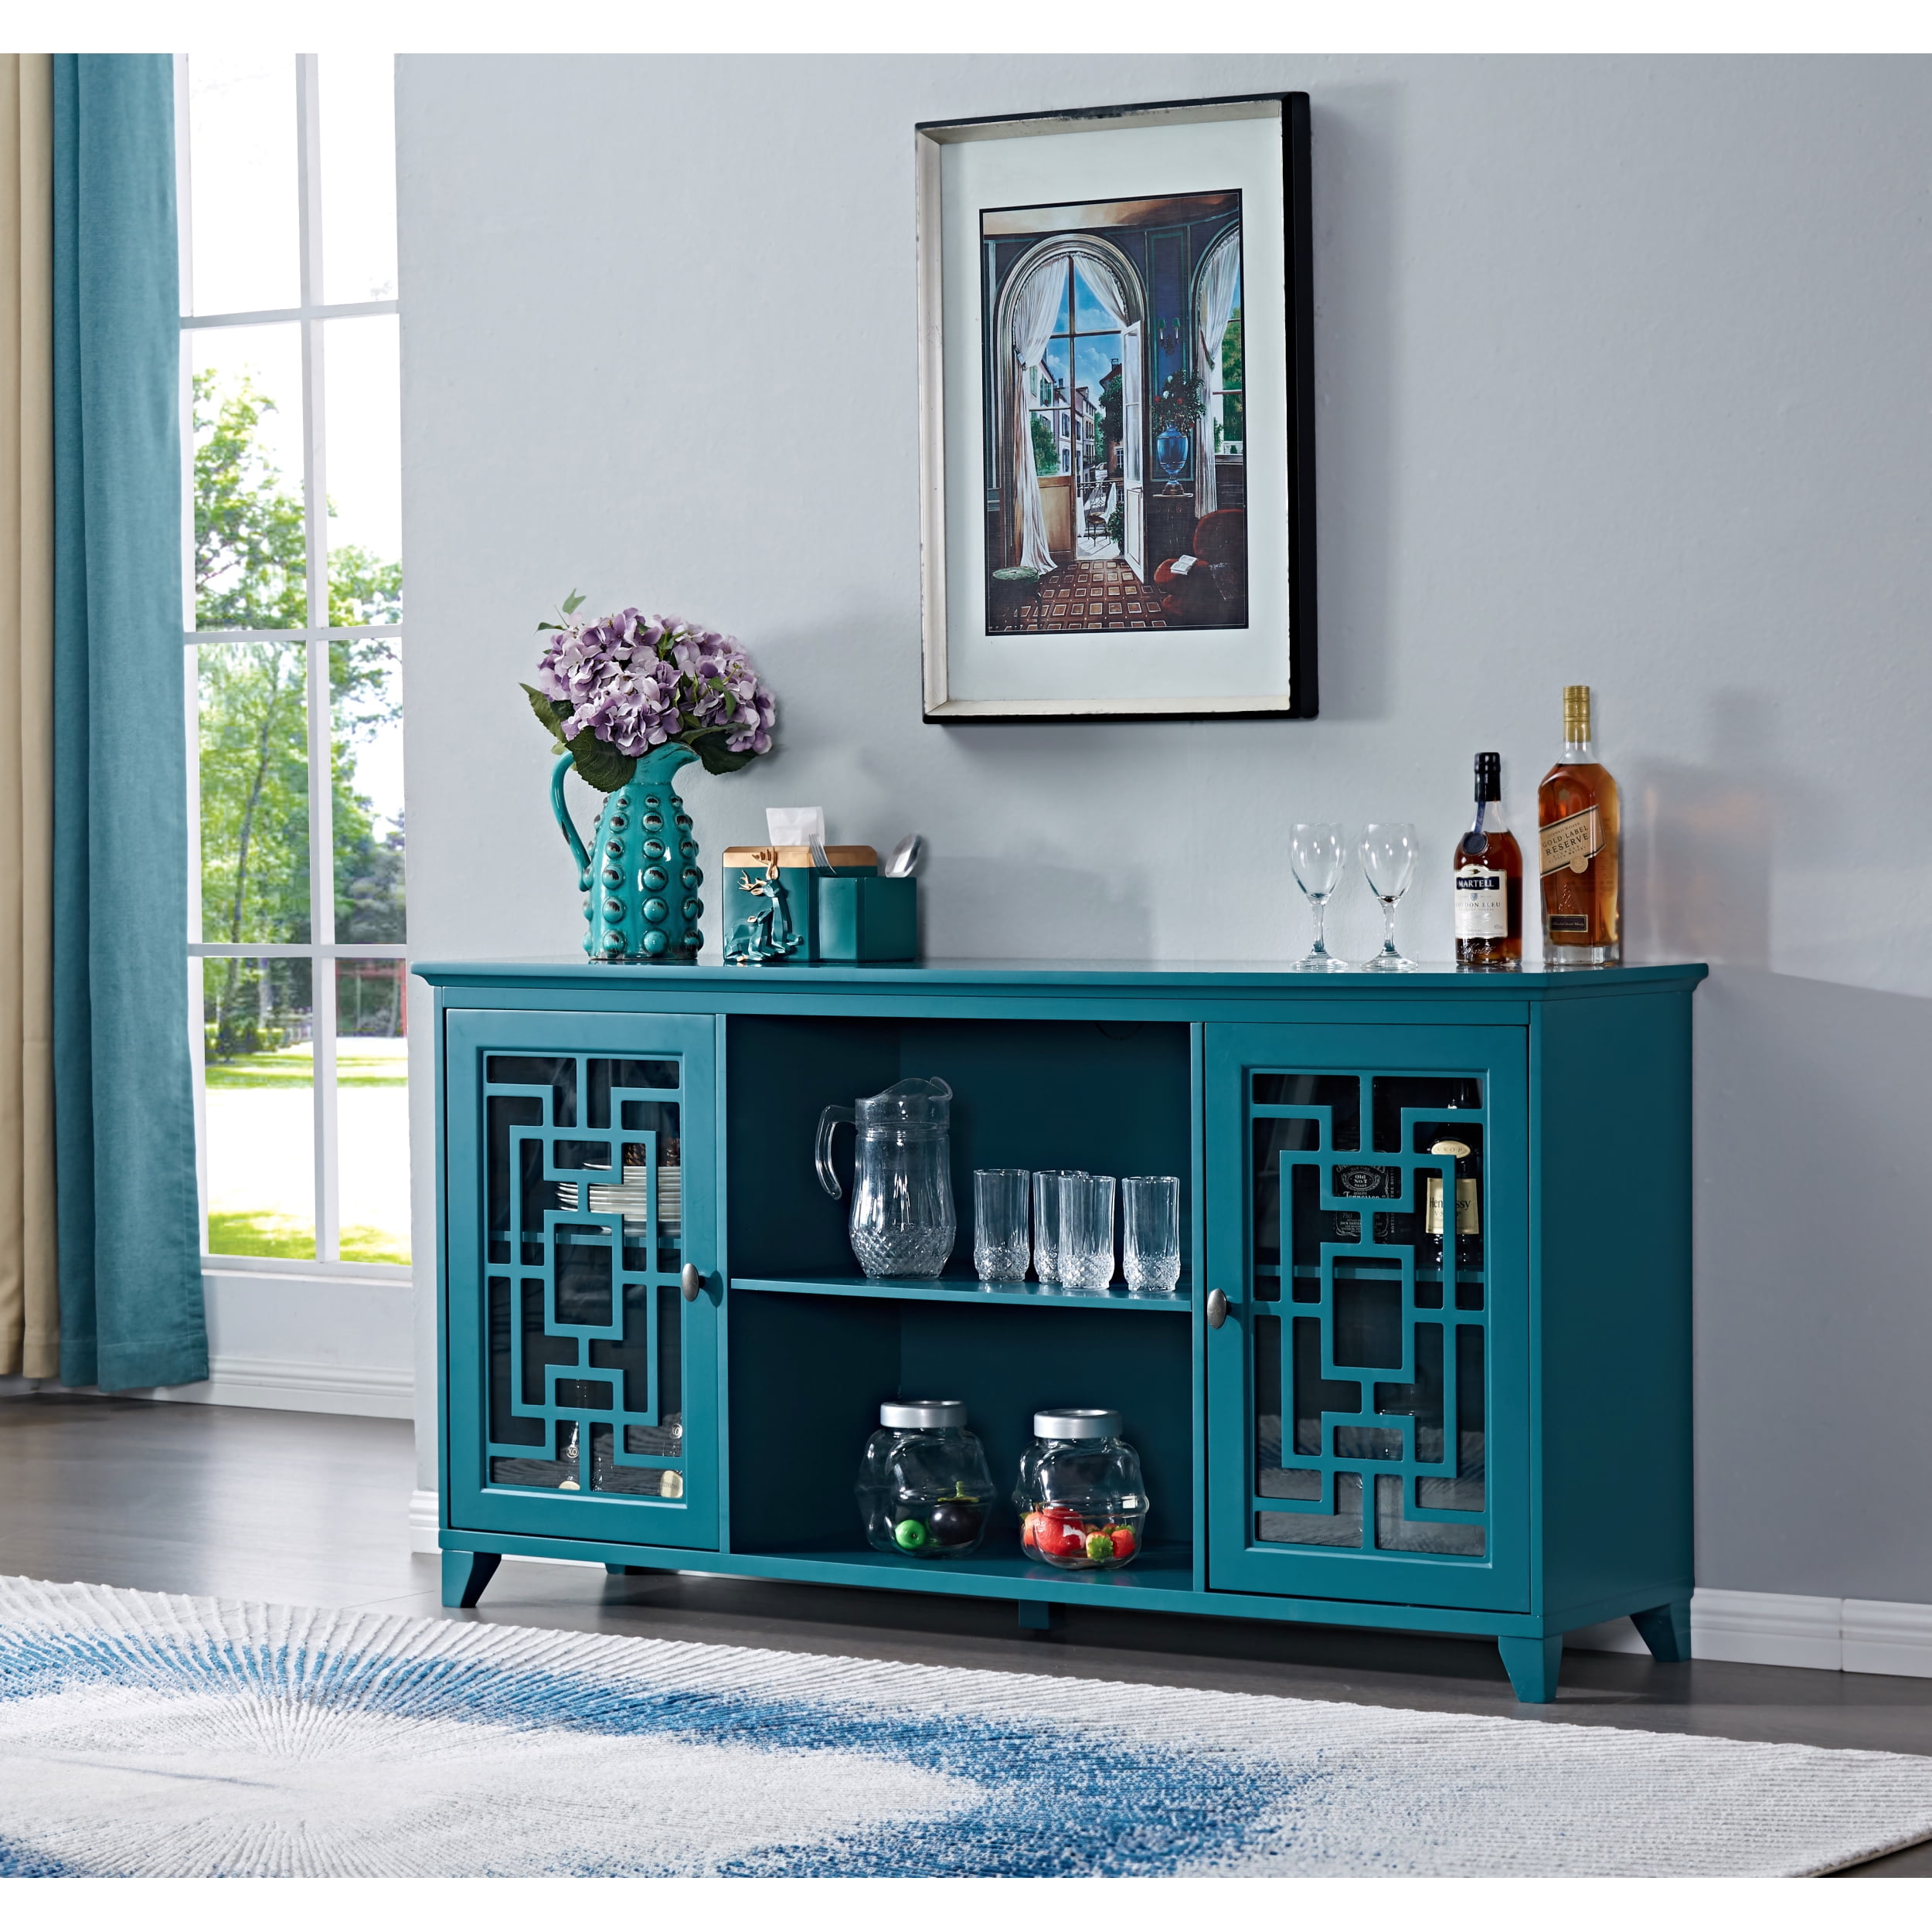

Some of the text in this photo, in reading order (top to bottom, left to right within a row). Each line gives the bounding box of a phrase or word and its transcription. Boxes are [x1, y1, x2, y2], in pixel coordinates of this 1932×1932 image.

[1542, 825, 1589, 848] GOLD LABEL
[1546, 832, 1589, 856] RESERVE
[1458, 879, 1495, 888] MARTELL
[1429, 1196, 1471, 1211] Henssy
[568, 1447, 577, 1456] XO
